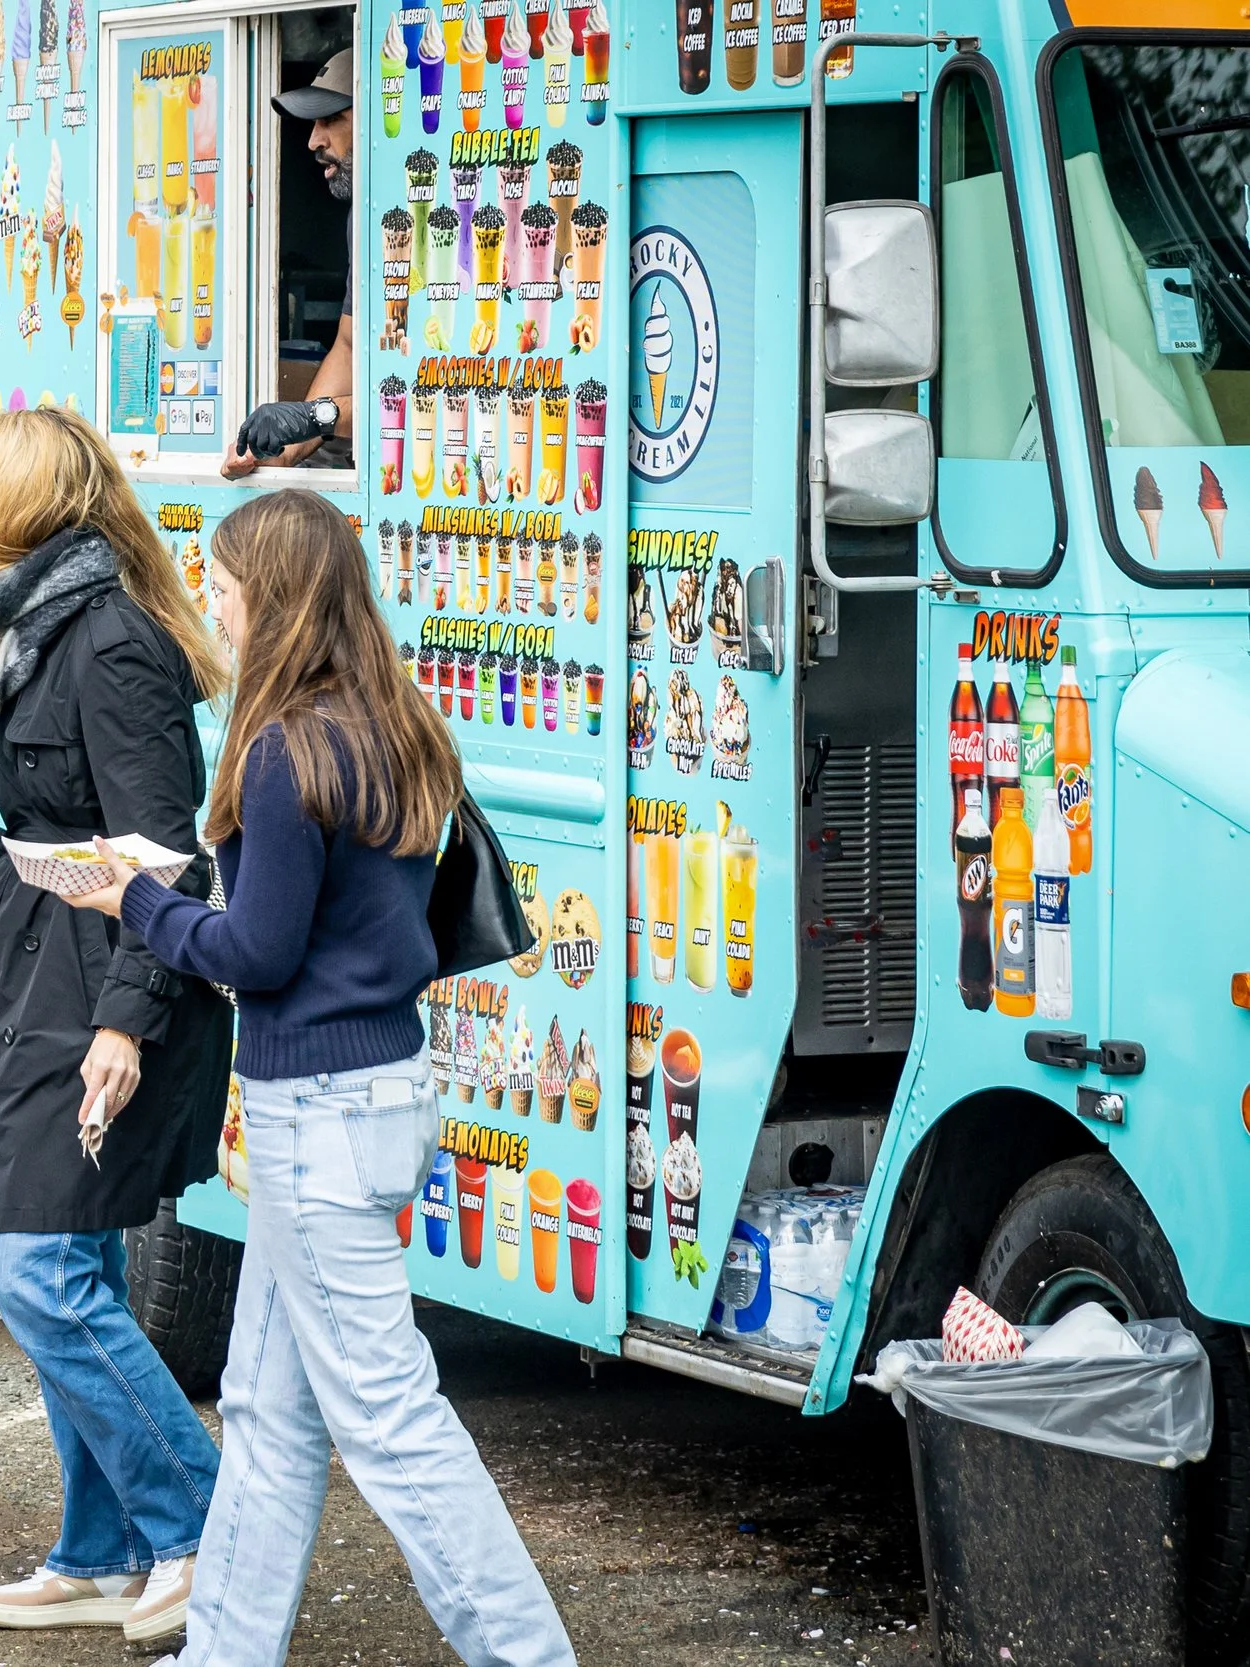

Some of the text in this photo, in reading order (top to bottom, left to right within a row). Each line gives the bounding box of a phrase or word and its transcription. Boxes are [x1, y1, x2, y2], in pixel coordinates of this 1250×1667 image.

[441, 2, 467, 22] MANGO
[687, 8, 702, 26] ICED
[730, 2, 754, 23] MOCHA
[725, 26, 759, 50] ICE COFFEE
[773, 21, 807, 45] ICE COFFEE
[819, 19, 839, 42] ICED
[683, 33, 706, 53] COFFEE
[141, 42, 212, 81] LEMONADES
[381, 76, 404, 95] LEMON
[501, 66, 529, 86] COTTON
[384, 96, 401, 115] LIME
[420, 94, 442, 113] GRAPE
[457, 90, 487, 110] ORANGE
[503, 87, 526, 107] CANDY
[450, 126, 540, 168] BUBBLE TEA
[456, 182, 477, 202] TARO
[504, 181, 524, 200] ROSE
[549, 179, 578, 198] MOCHA
[383, 260, 410, 278] BROWN
[630, 239, 693, 281] ROCKY
[384, 283, 409, 301] SUGAR
[476, 281, 501, 301] MANGO
[518, 281, 558, 300] STRAWBERRY
[576, 281, 600, 300] PEACH
[417, 355, 495, 390] SMOOTHIES
[522, 356, 563, 393] BOBA
[421, 505, 500, 538] MILKSHAKES
[524, 510, 562, 542] BOBA
[628, 528, 720, 574] SUNDAES!
[421, 615, 487, 656] SLUSHIES
[514, 624, 555, 662] BOBA
[972, 610, 1063, 666] DRINKS
[666, 737, 705, 757] CHOCOLATE
[986, 737, 1019, 763] Coke
[1024, 734, 1054, 772] Sprite
[677, 755, 693, 774] NUT
[711, 760, 753, 782] SPRINKLES
[1039, 882, 1059, 896] DEER
[1039, 894, 1060, 909] PARK
[654, 920, 674, 939] PEACH
[693, 928, 711, 945] MINT
[1002, 908, 1024, 954] G
[726, 940, 750, 961] COLADA
[455, 976, 509, 1022] BOWLS
[631, 1085, 642, 1101] HOT
[671, 1102, 692, 1120] HOT TEA
[437, 1115, 529, 1173] LEMONADES
[429, 1183, 444, 1200] BLUE
[460, 1191, 483, 1211] CHERRY
[633, 1193, 643, 1208] HOT
[420, 1198, 454, 1223] RASPBERRY
[671, 1202, 681, 1218] HOT
[531, 1210, 559, 1233] ORANGE
[566, 1219, 603, 1247] WATERMELON
